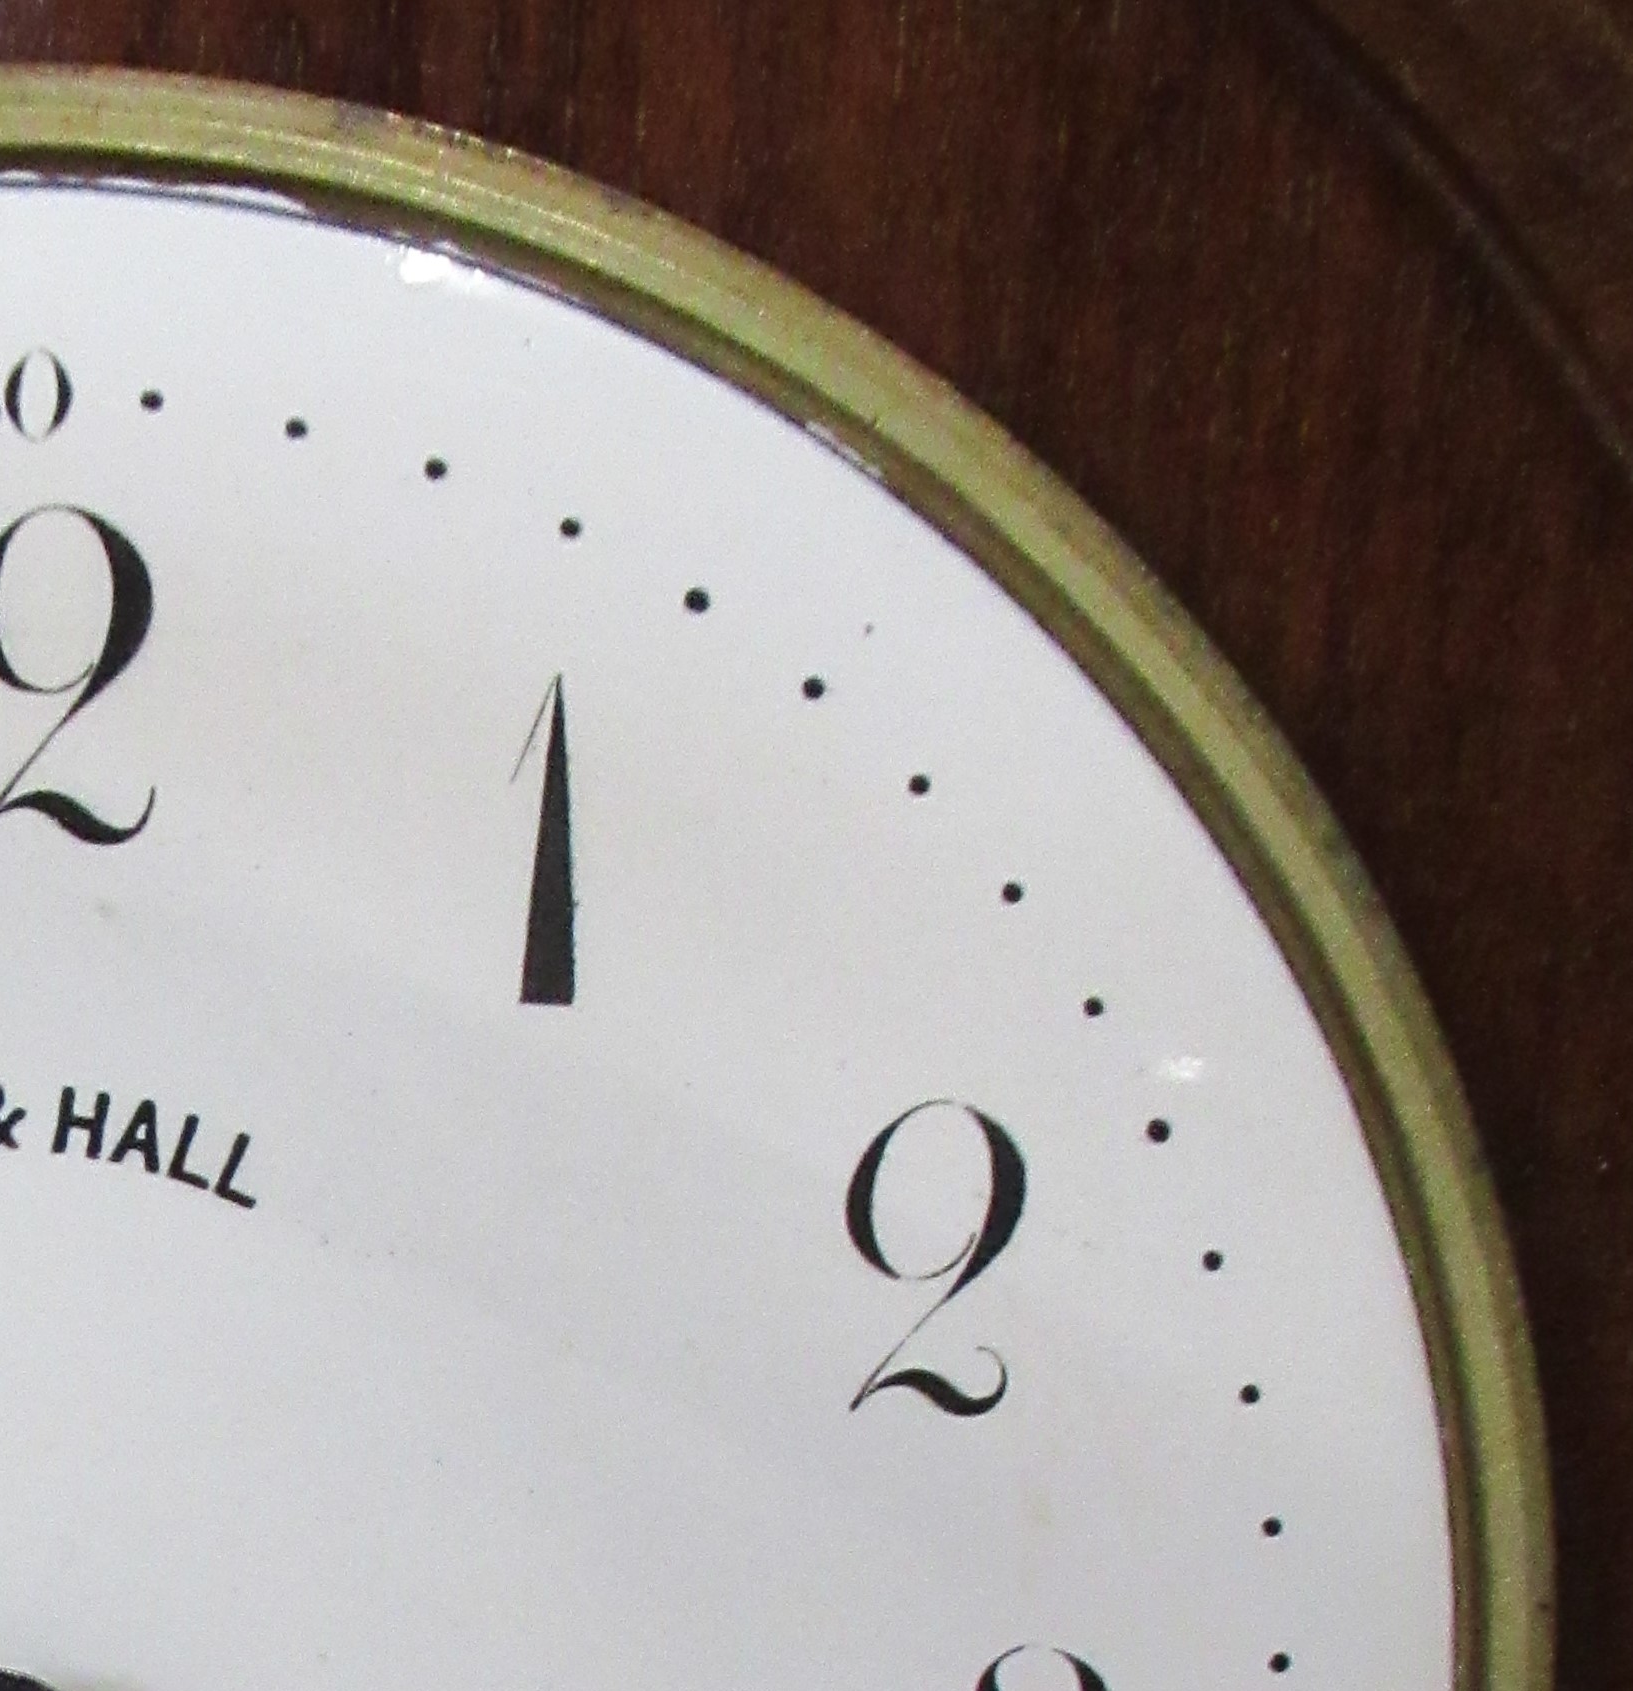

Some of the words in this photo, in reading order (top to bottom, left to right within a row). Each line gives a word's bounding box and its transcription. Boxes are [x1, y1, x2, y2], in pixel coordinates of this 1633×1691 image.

[511, 674, 579, 1007] 1
[51, 1086, 256, 1209] HALL
[845, 1101, 1027, 1417] 2
